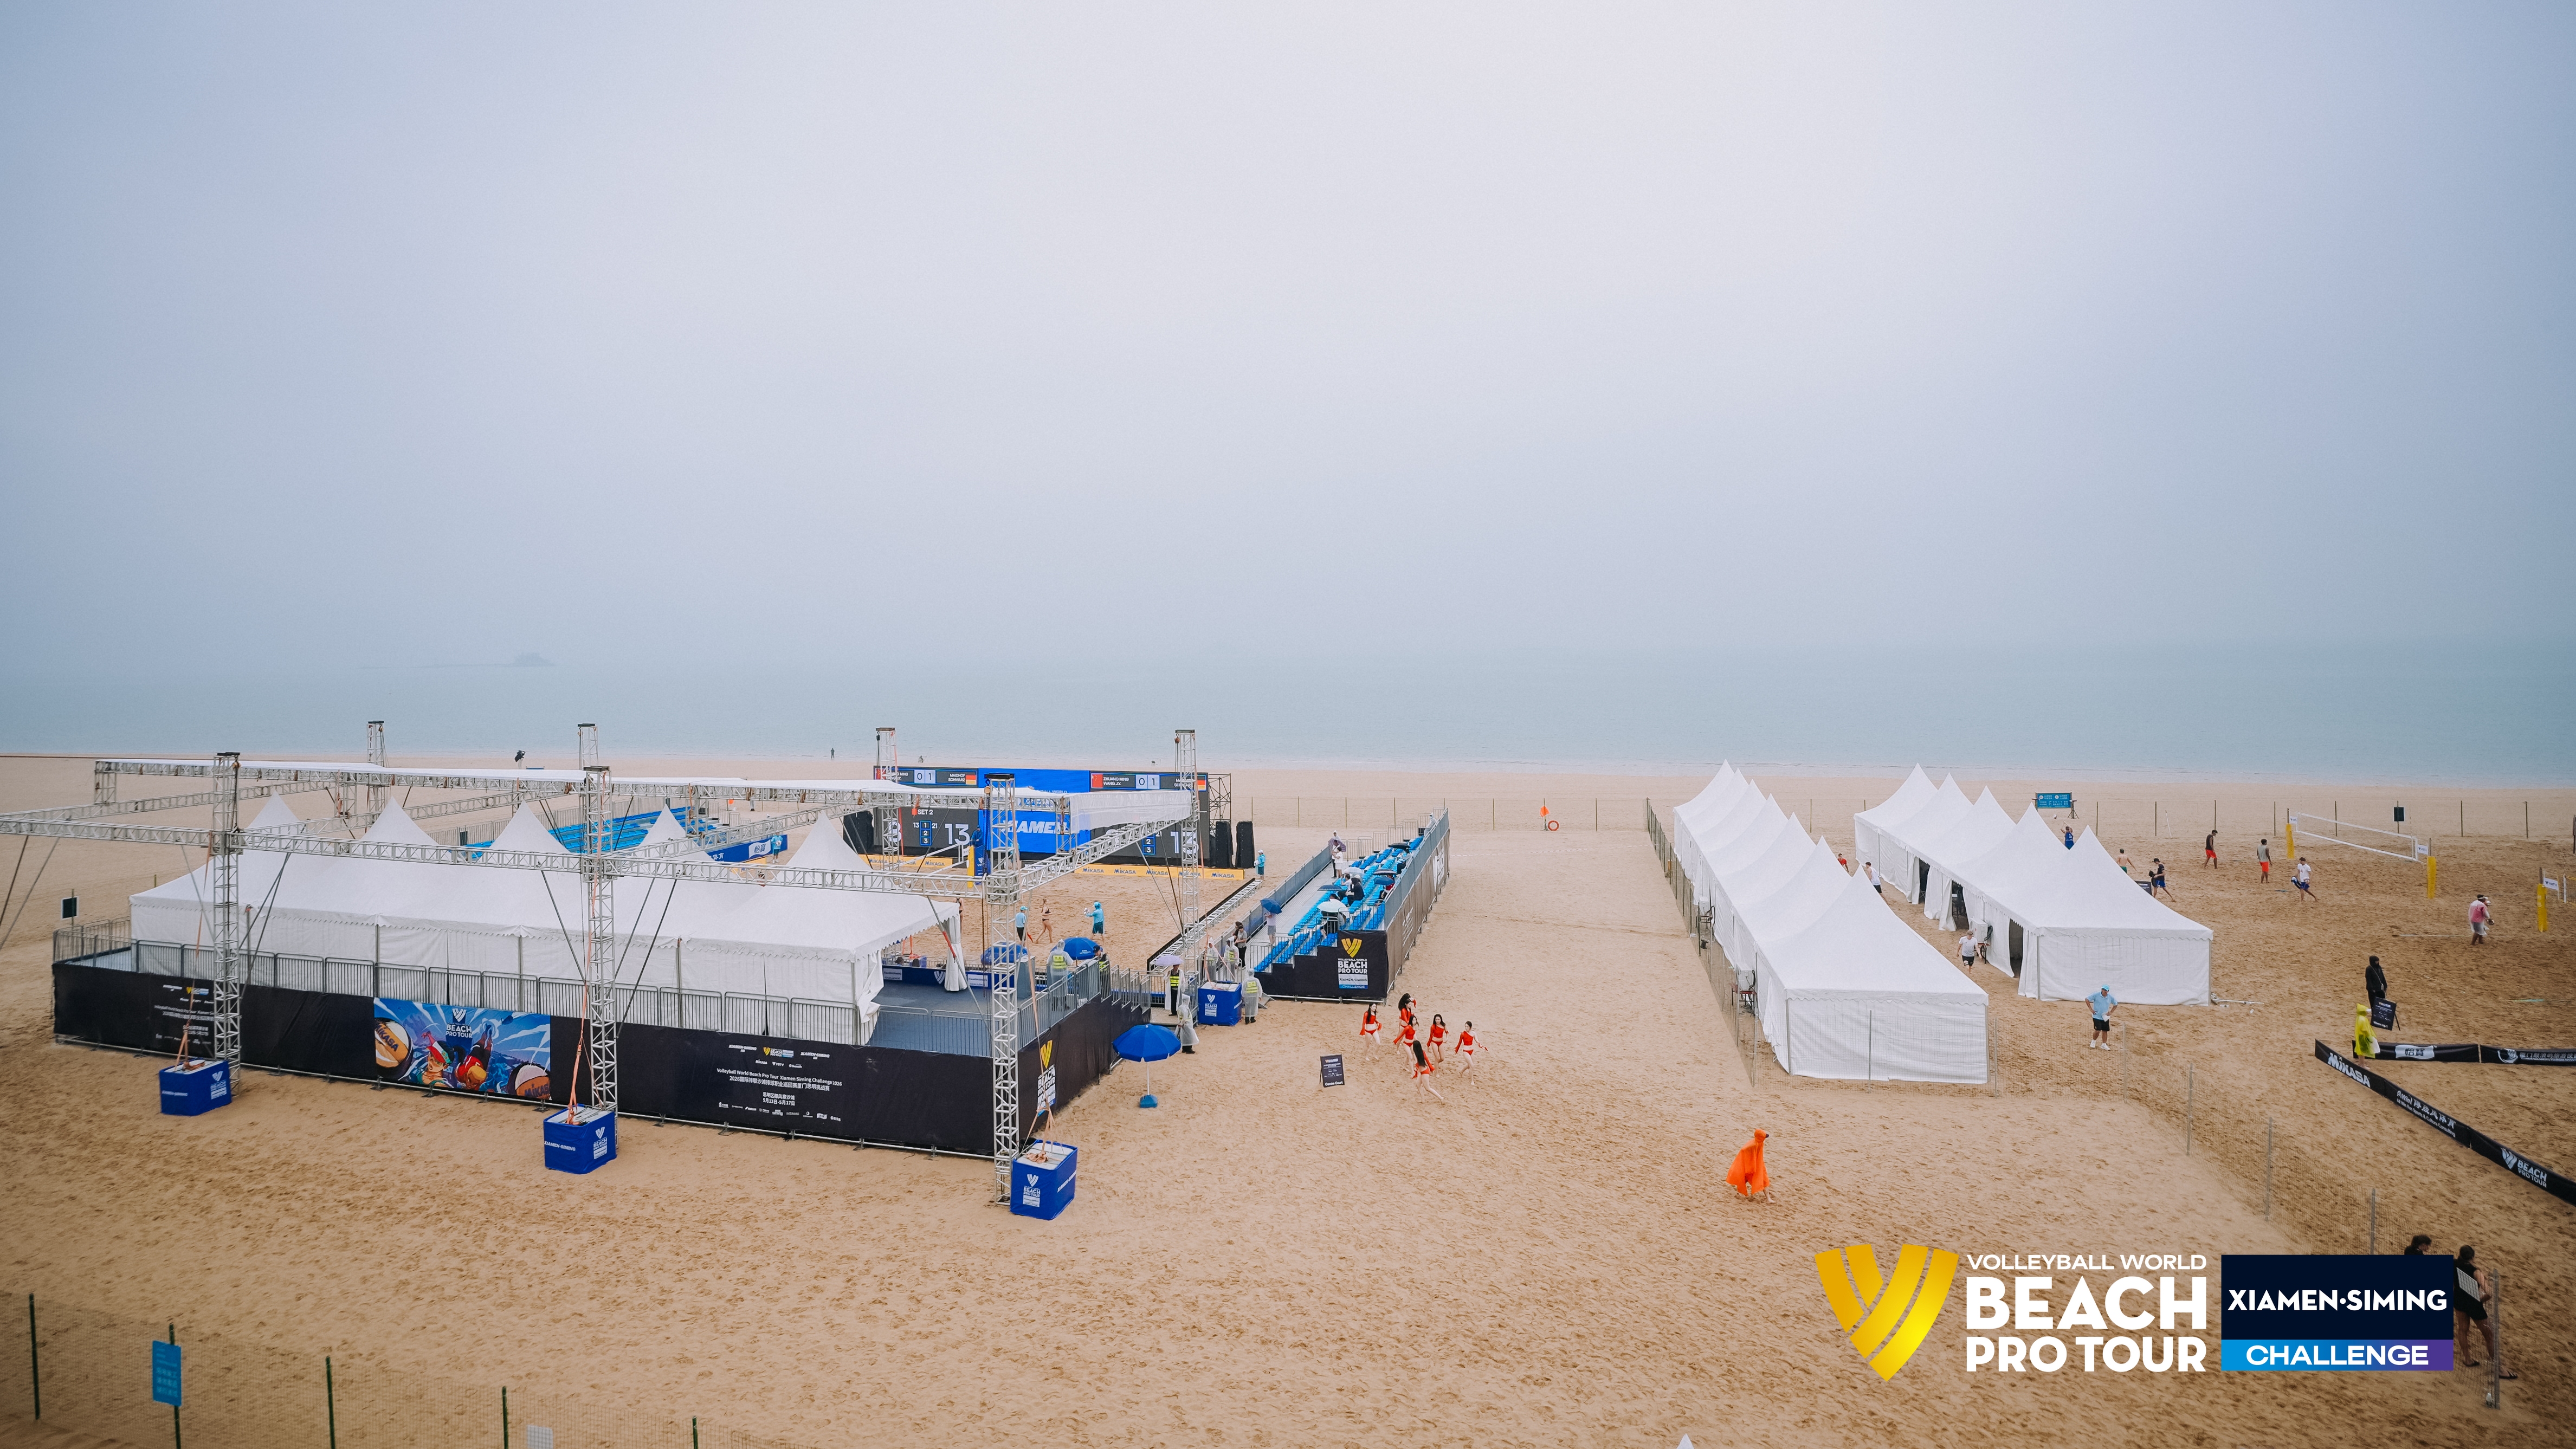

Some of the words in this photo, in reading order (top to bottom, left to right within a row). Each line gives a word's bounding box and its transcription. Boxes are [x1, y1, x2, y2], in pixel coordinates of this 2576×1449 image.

[945, 824, 970, 845] 13
[1338, 961, 1367, 969] BEACH
[446, 1024, 472, 1033] BEACH
[593, 1138, 607, 1148] BEACH
[2517, 1159, 2547, 1182] BEACH
[2518, 1167, 2530, 1179] PRO
[2530, 1174, 2547, 1188] TOUR
[1024, 1187, 1041, 1195] BEACH
